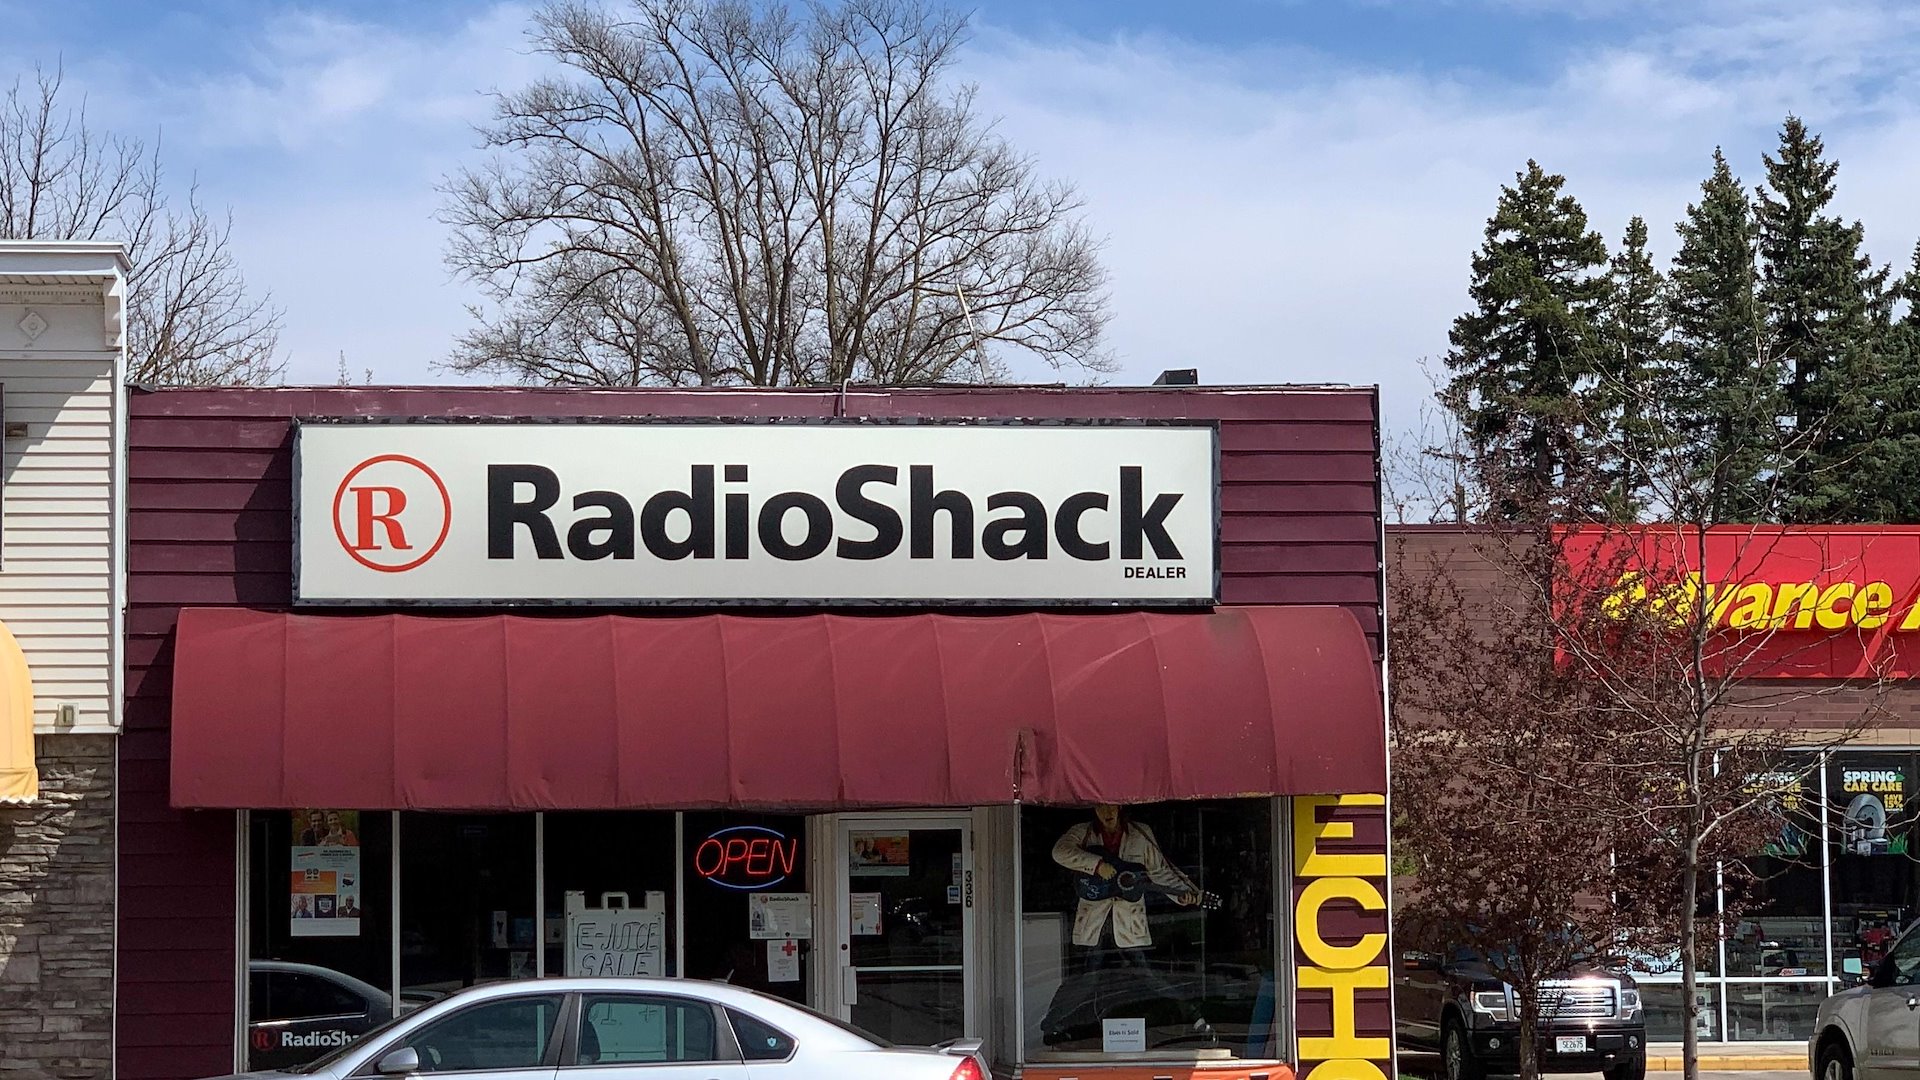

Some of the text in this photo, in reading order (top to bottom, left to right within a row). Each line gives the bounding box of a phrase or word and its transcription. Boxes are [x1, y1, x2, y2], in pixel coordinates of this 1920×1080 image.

[487, 463, 1184, 561] RadioShack
[1124, 566, 1187, 579] DEALER
[1843, 770, 1897, 783] SPRING
[1843, 782, 1903, 792] CAR CARE
[696, 839, 797, 875] OPEN
[965, 871, 974, 908] 336
[576, 921, 659, 952] E-JUICE
[580, 952, 653, 976] SALE
